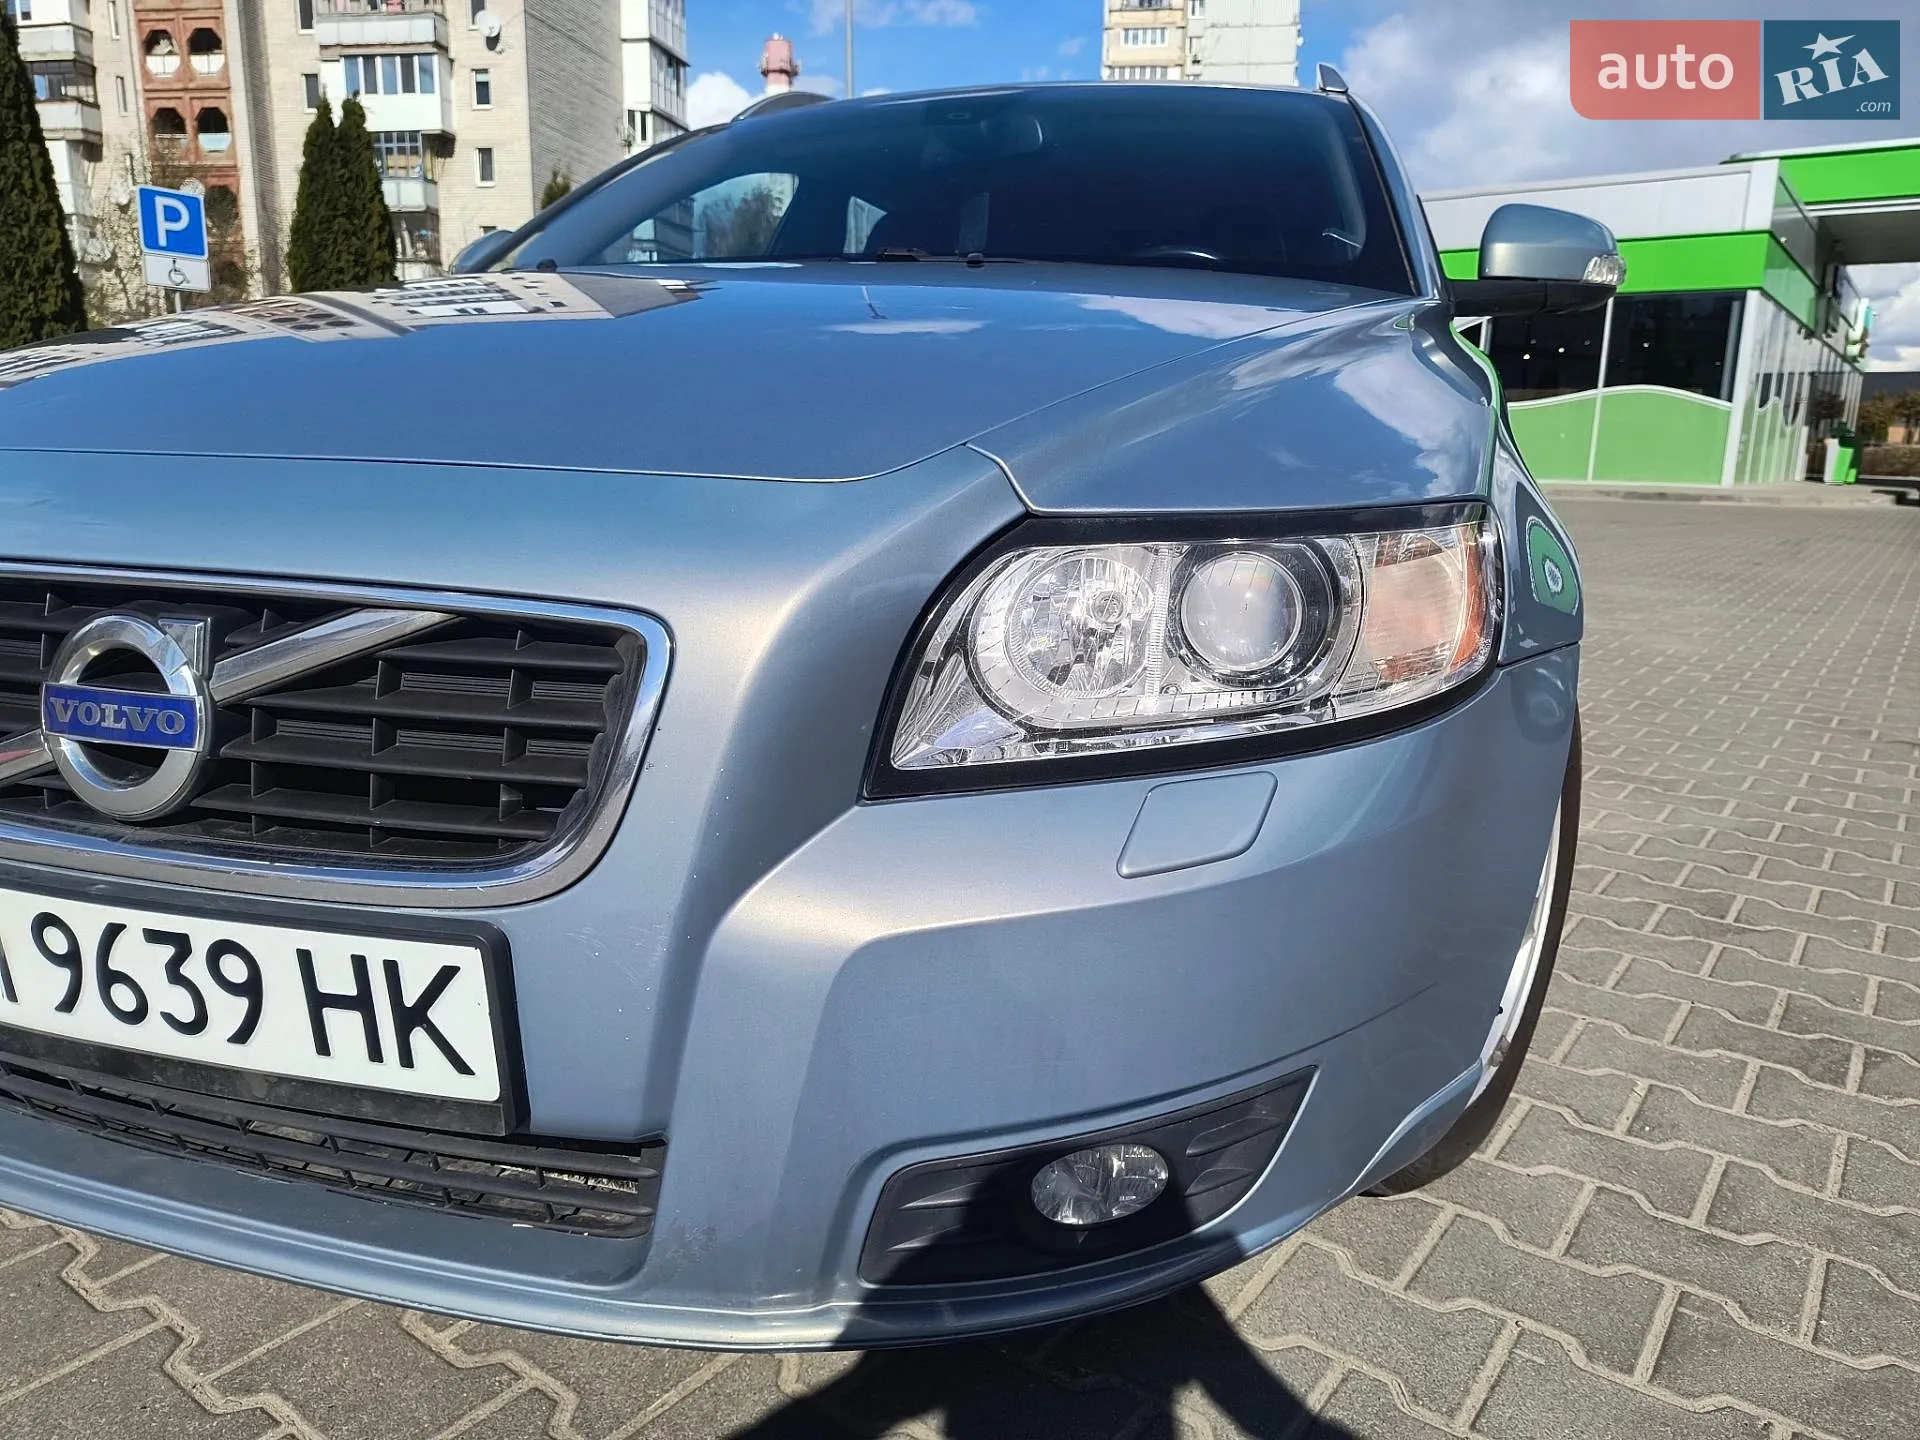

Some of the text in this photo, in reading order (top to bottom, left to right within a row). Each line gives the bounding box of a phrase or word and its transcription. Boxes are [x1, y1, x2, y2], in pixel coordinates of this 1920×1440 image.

[154, 195, 190, 247] P
[50, 697, 186, 735] VOLVO
[31, 911, 263, 1044] 9639
[296, 948, 475, 1075] HK
